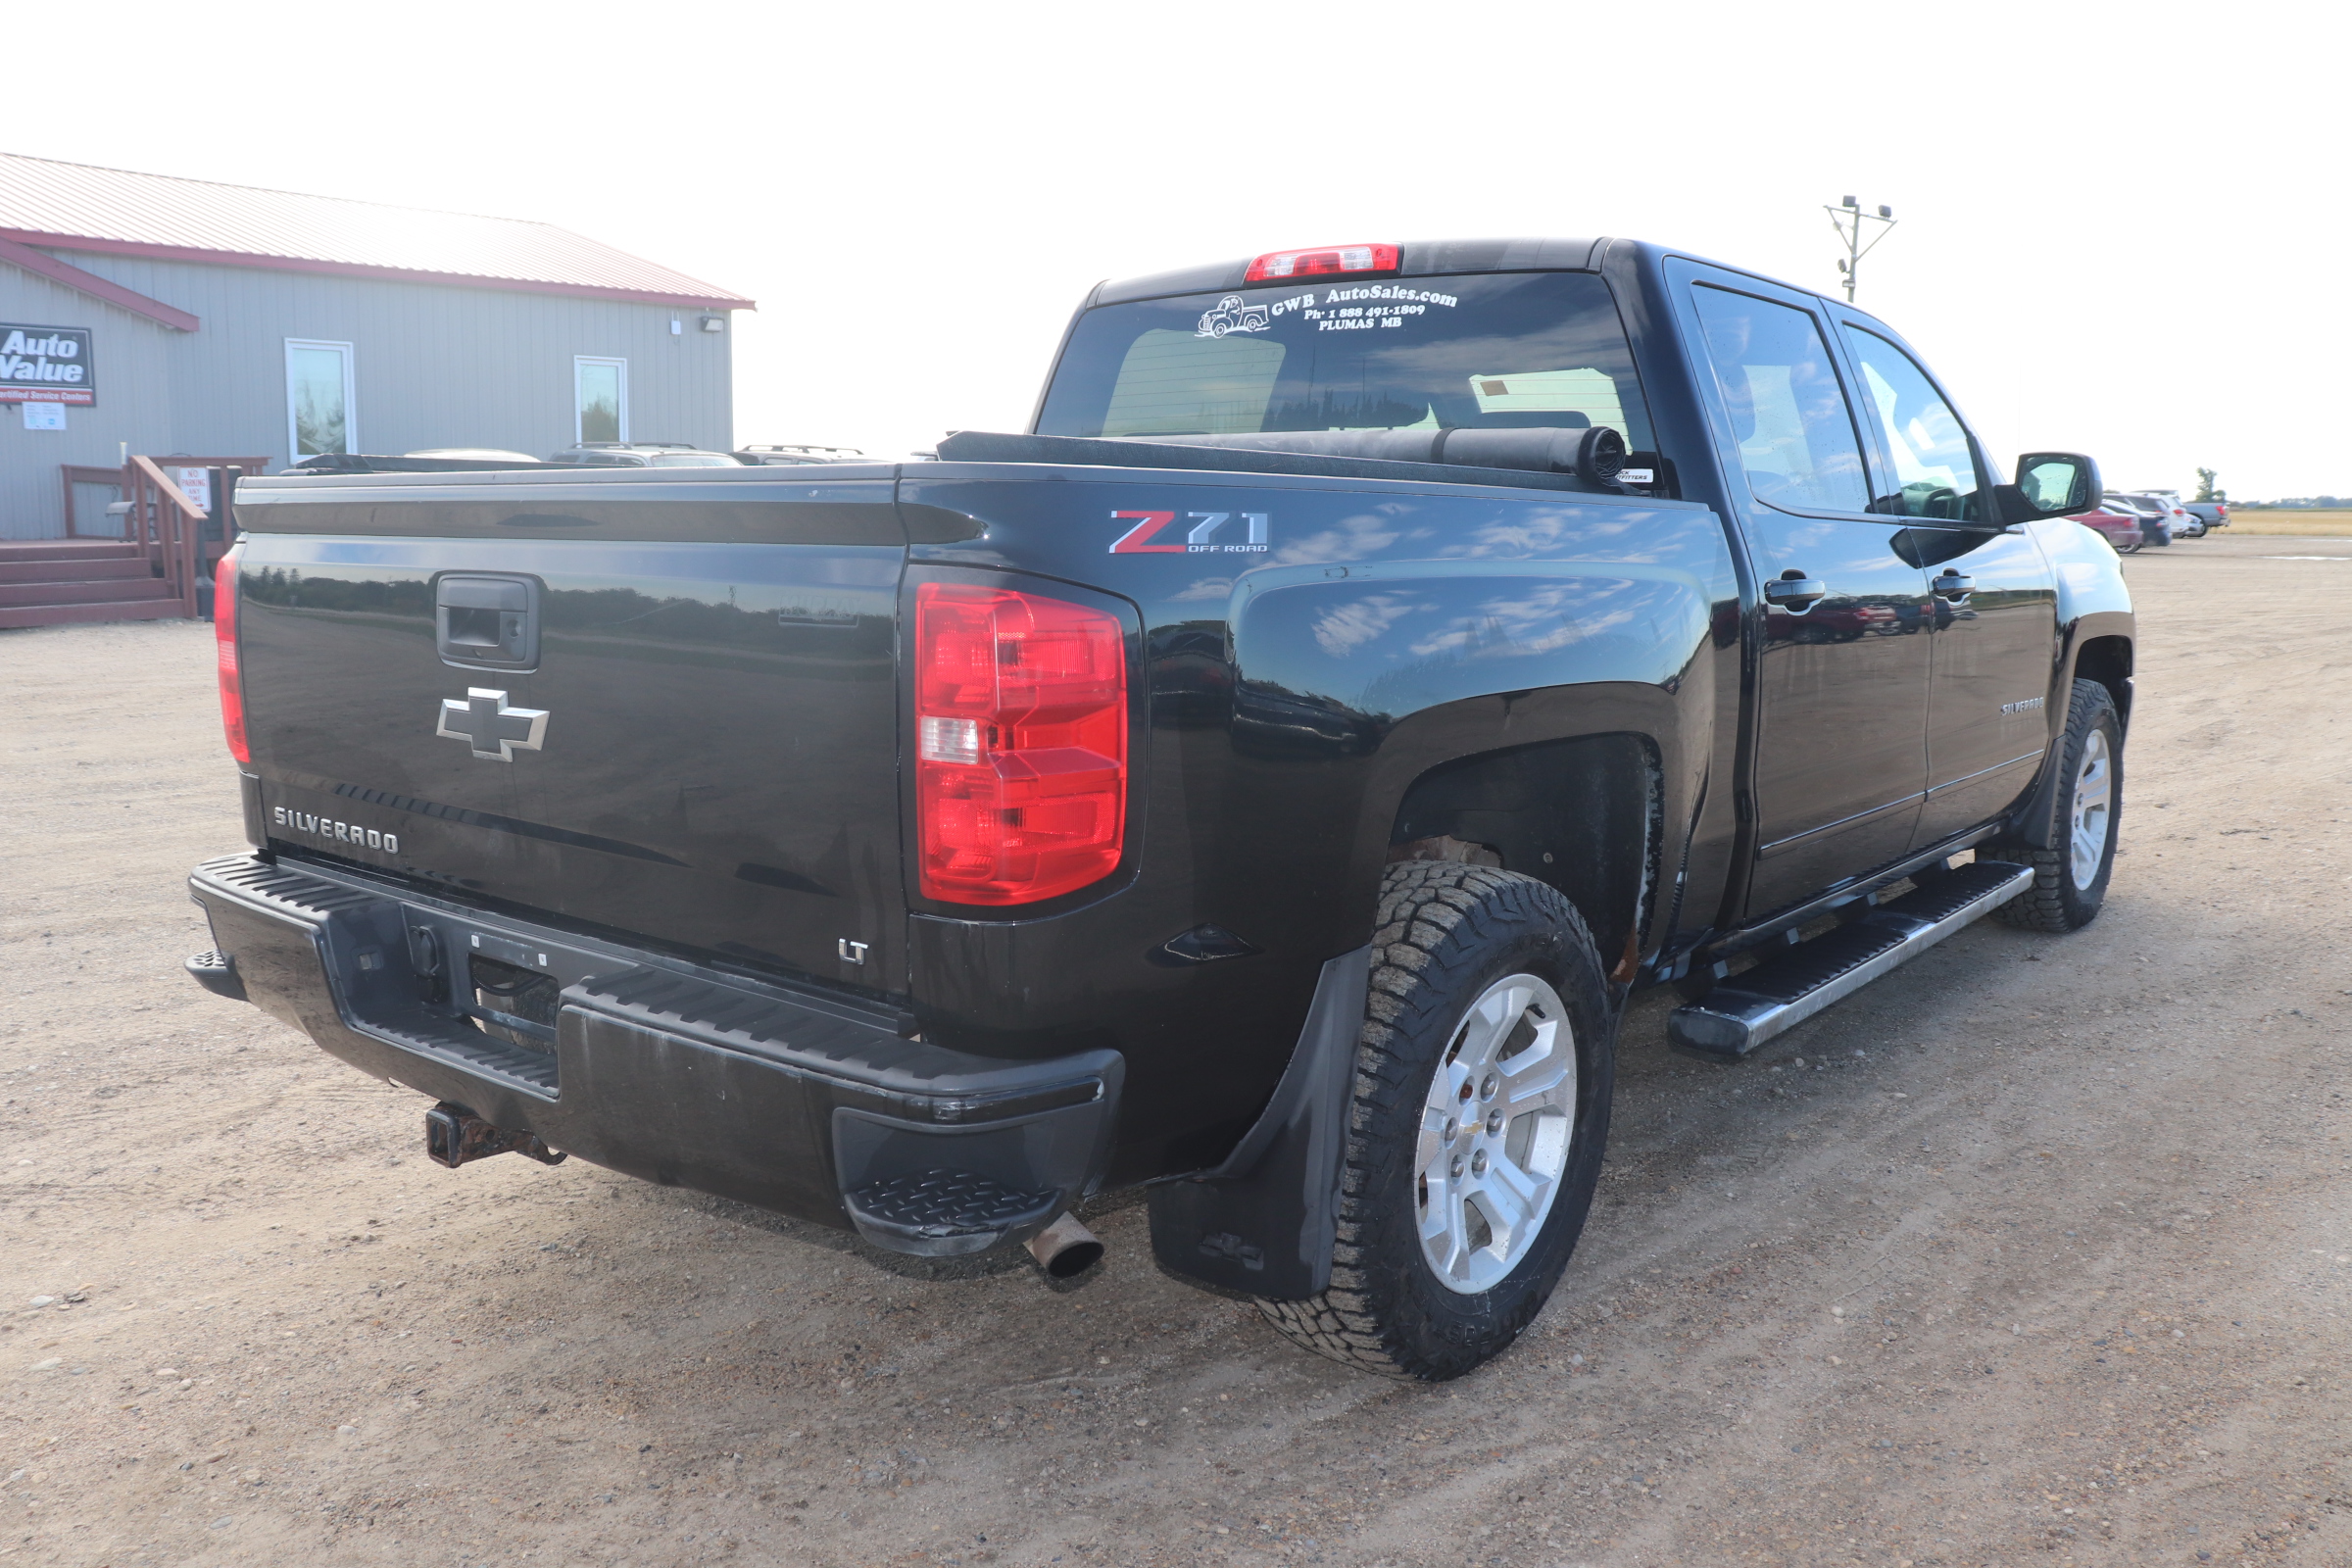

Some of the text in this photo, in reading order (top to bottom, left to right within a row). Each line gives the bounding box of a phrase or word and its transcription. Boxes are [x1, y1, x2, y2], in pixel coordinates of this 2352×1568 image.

[1271, 284, 1457, 316] GWB AutoSales.com
[1328, 309, 1336, 318] 1
[1339, 307, 1363, 318] 888
[1365, 305, 1425, 318] 491-1809
[1319, 317, 1402, 330] PLUMAS MB
[0, 330, 78, 358] Auto
[0, 355, 84, 382] Value
[0, 390, 91, 401] ertified Service Centers
[187, 469, 199, 478] NO
[1108, 510, 1268, 554] Z71
[2000, 696, 2044, 716] SILVERADO
[273, 806, 400, 855] SILVERADO
[838, 938, 869, 965] LT
